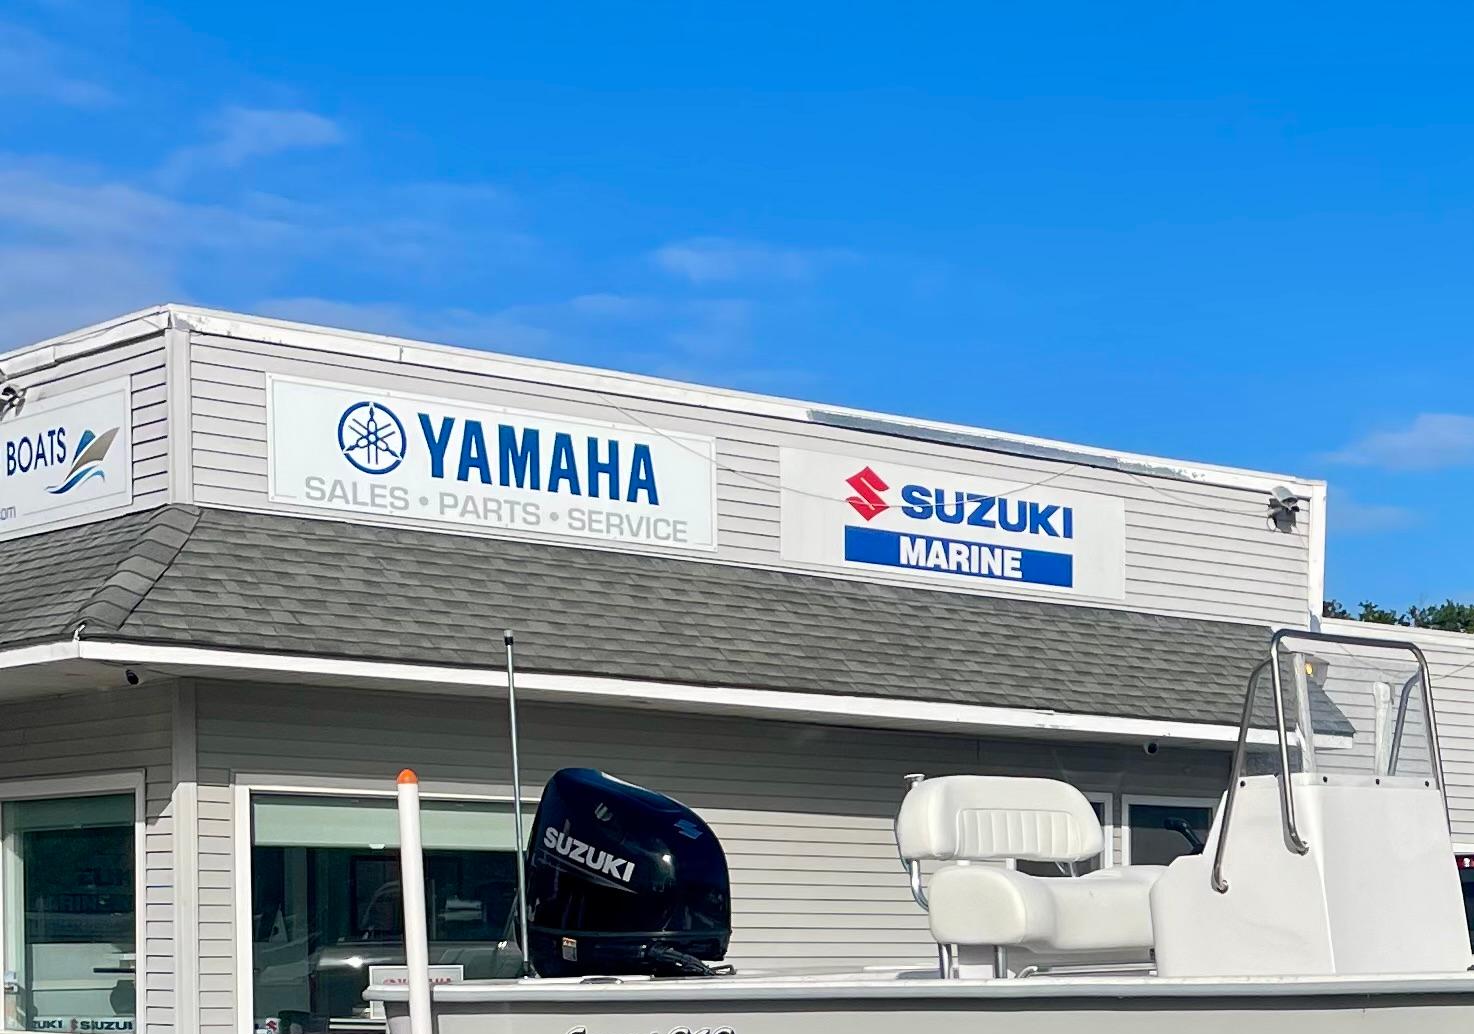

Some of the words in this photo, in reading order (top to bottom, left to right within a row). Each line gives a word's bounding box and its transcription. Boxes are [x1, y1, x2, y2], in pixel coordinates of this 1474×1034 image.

[7, 427, 66, 476] BOATS
[418, 412, 660, 506] YAMAHA
[0, 505, 16, 520] om
[305, 476, 409, 511] SALES
[439, 492, 541, 525] PARTS
[567, 507, 688, 542] SERVICE
[901, 484, 1073, 539] SUZUKI
[900, 535, 1023, 579] MARINE
[543, 827, 635, 882] SUZUKI
